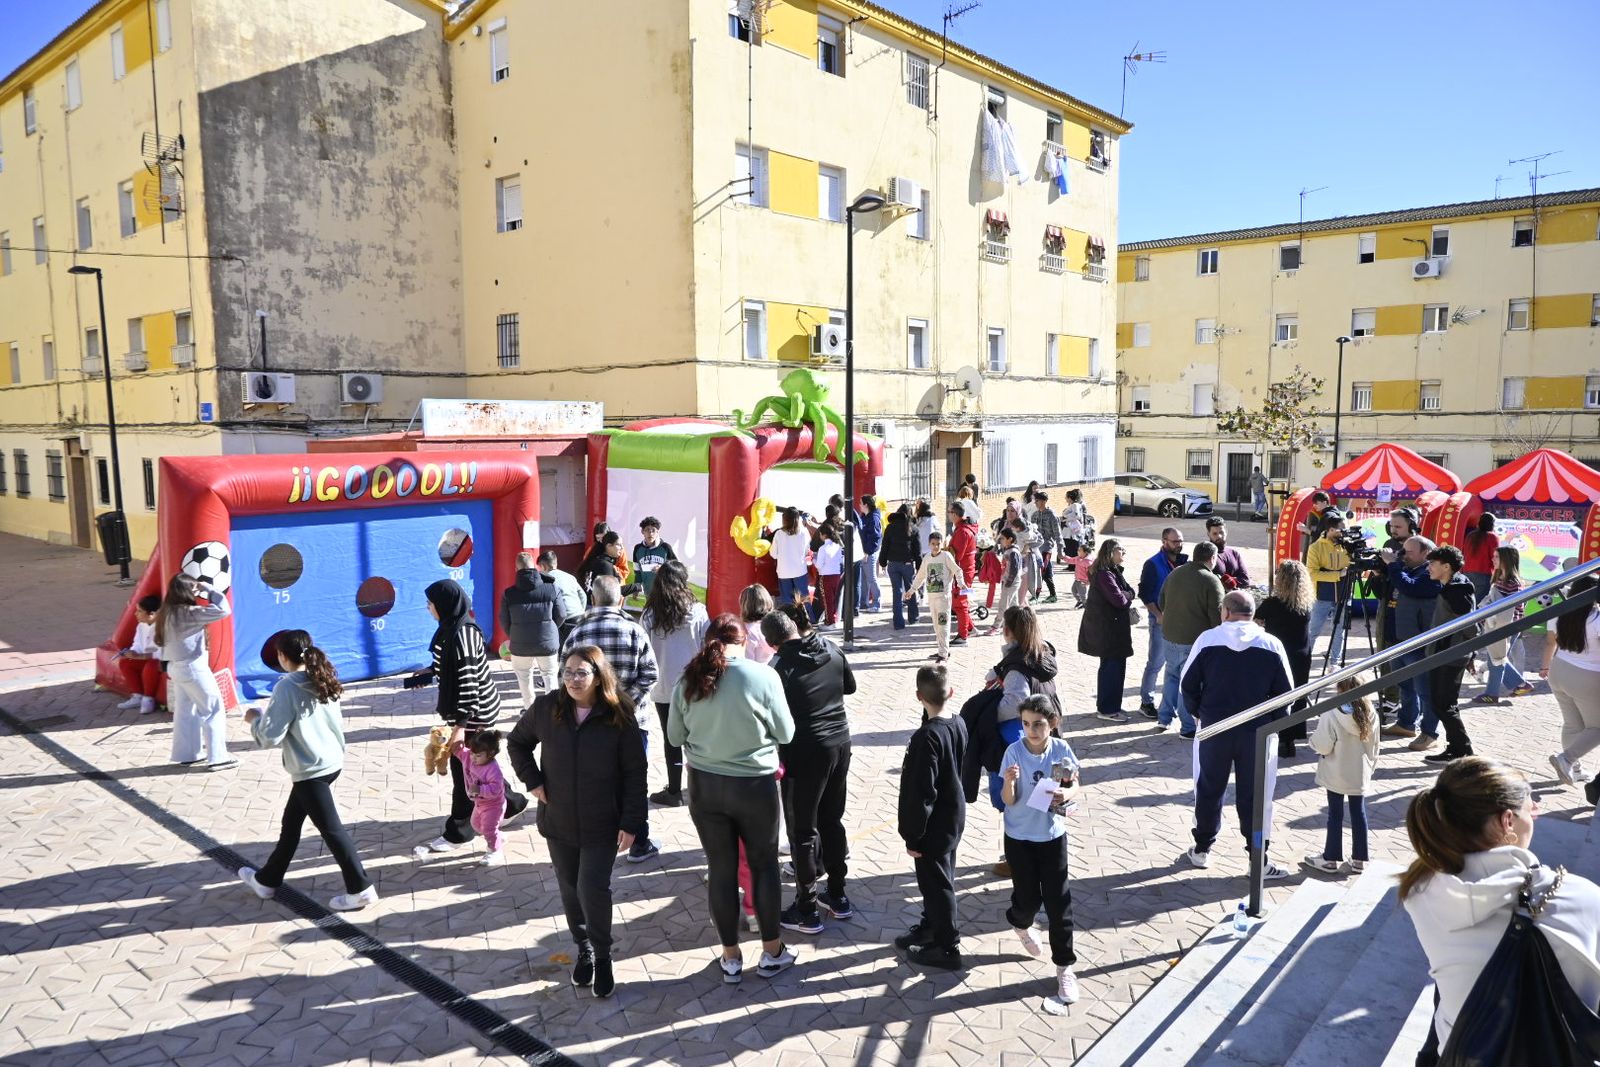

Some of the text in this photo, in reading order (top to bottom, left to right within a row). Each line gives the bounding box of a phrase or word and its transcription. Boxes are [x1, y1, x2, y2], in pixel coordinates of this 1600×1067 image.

[1505, 508, 1576, 521] SOCCER
[1516, 524, 1561, 535] GOAL
[449, 569, 464, 581] 100
[273, 590, 291, 605] 75
[370, 618, 385, 632] 50
